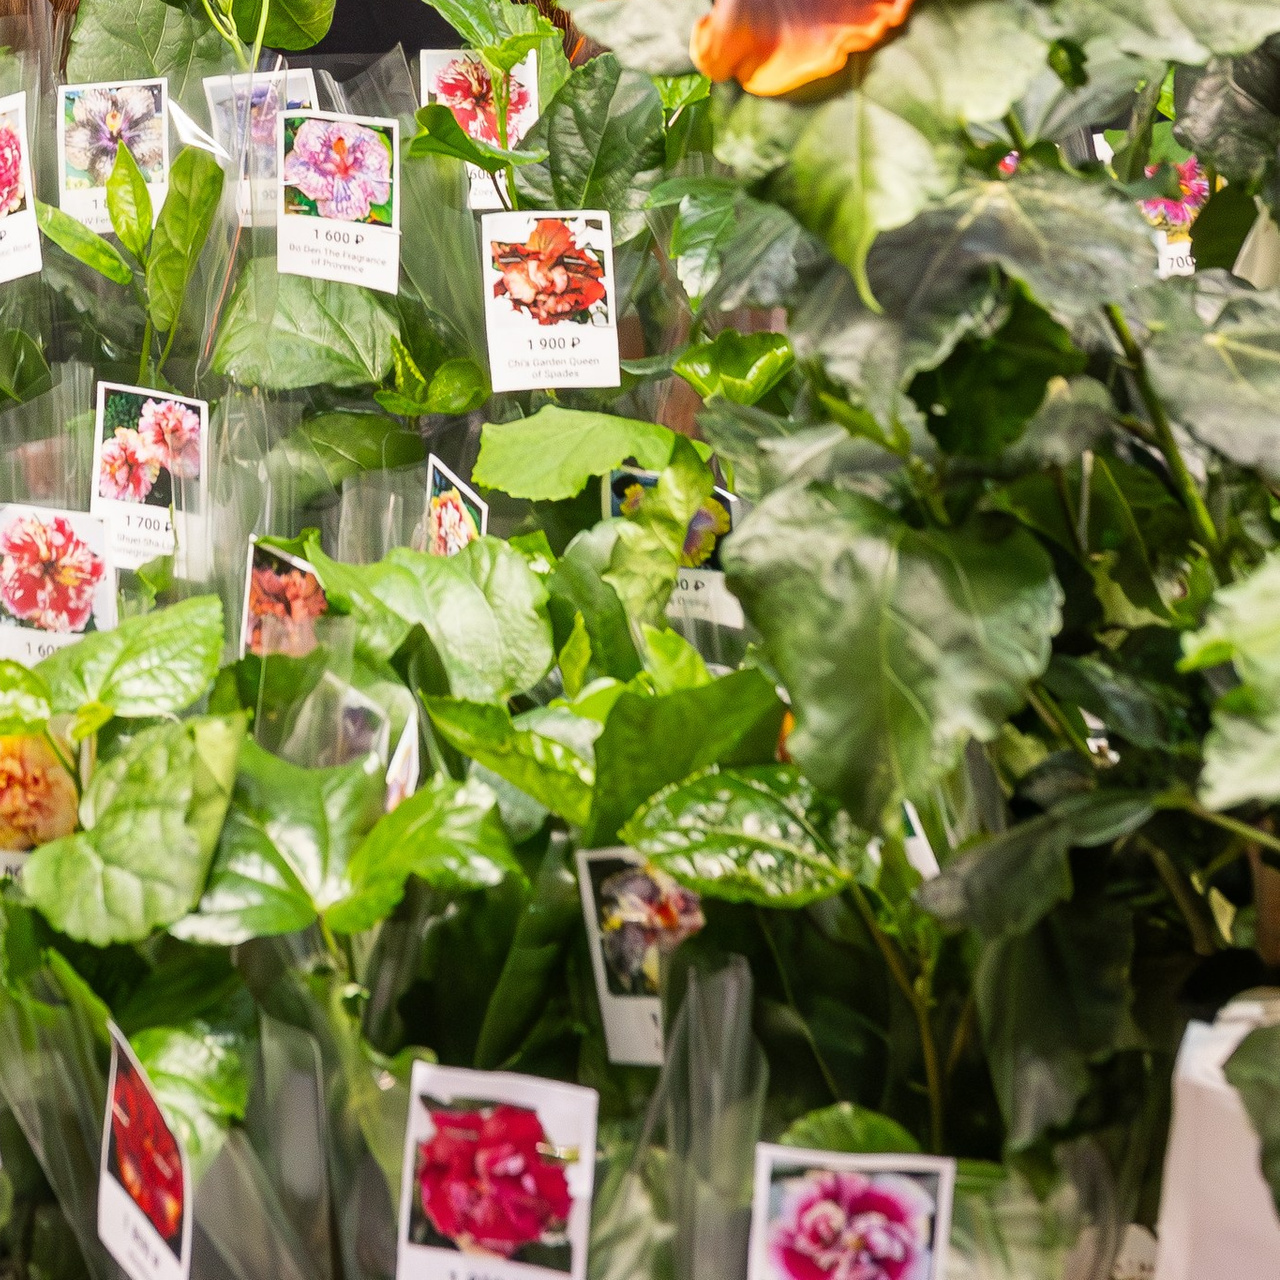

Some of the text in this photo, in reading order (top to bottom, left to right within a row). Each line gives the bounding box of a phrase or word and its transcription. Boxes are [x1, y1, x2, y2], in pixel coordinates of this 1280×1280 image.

[325, 229, 350, 245] 600
[303, 243, 321, 255] Den
[323, 246, 340, 259] The
[341, 250, 387, 268] Fragrance
[1167, 255, 1197, 269] 700
[310, 255, 365, 274] of Provence
[539, 336, 566, 350] 900
[532, 357, 566, 369] Garden
[568, 356, 600, 368] Queen
[532, 368, 579, 380] of Spades
[136, 516, 161, 532] 700
